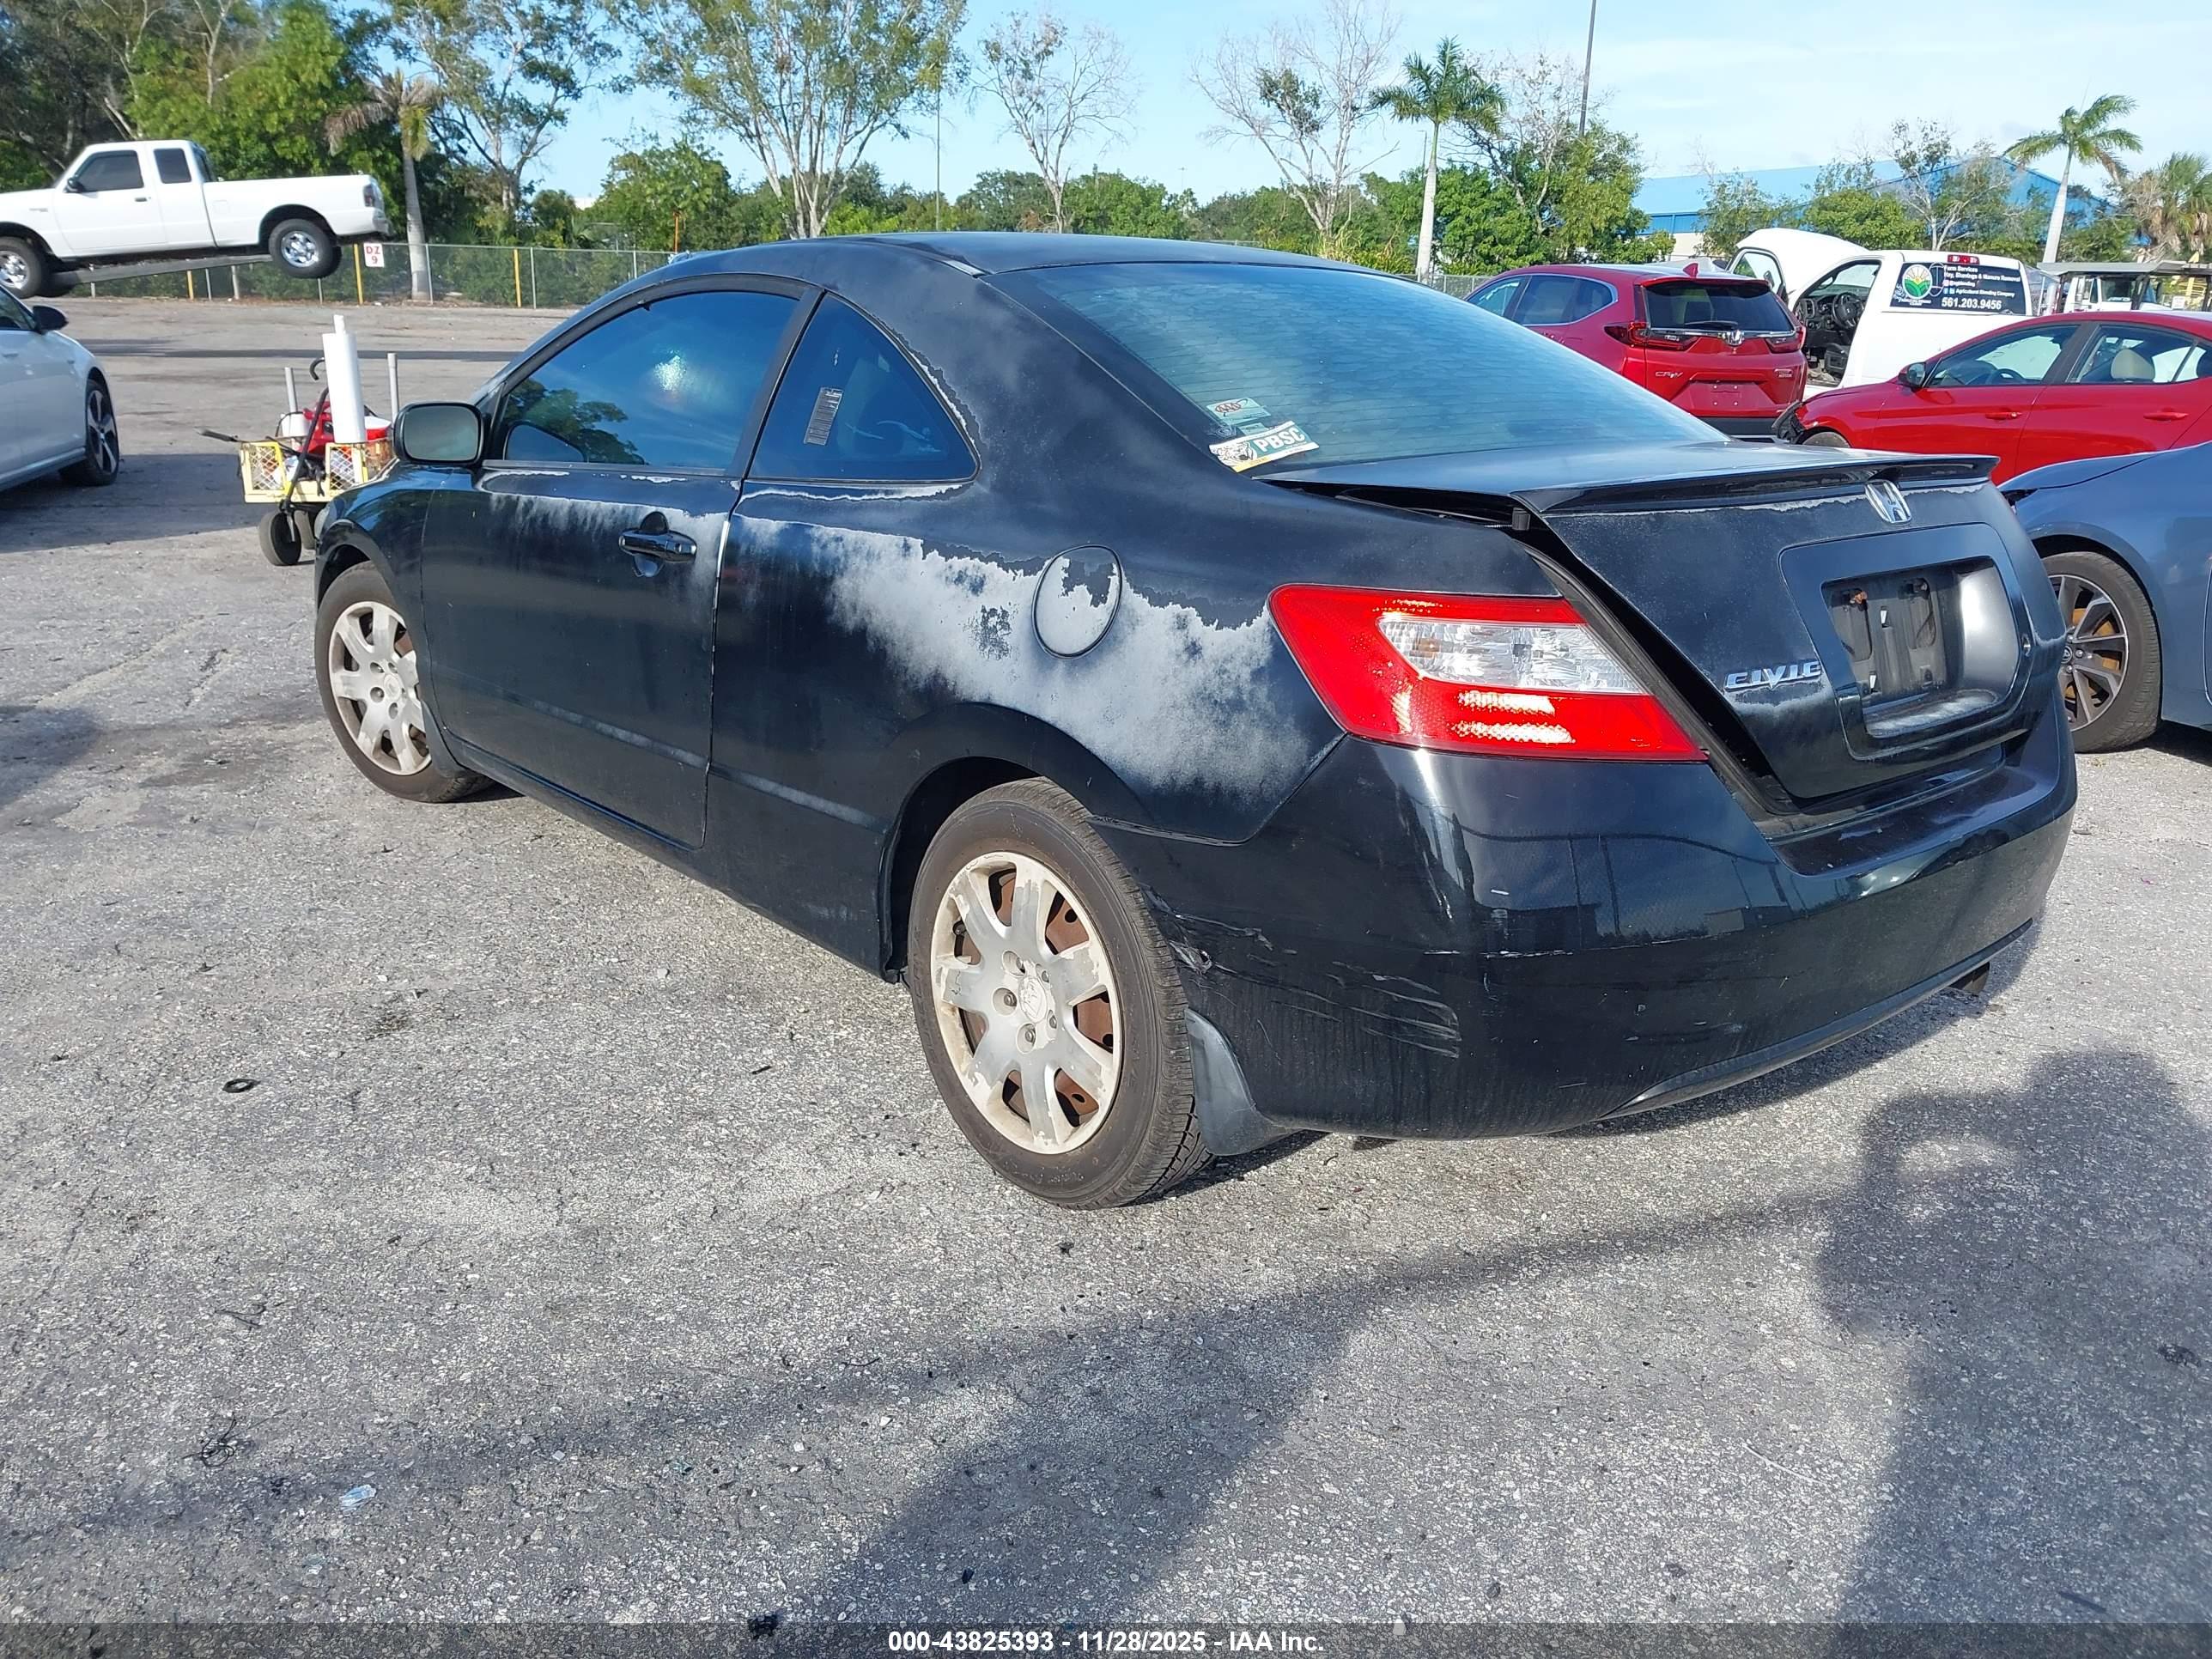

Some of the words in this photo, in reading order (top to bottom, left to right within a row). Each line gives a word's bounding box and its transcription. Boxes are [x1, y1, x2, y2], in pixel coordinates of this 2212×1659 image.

[366, 246, 380, 254] DZ
[371, 255, 378, 264] 9
[1942, 297, 2002, 310] 561.203.9456
[1253, 427, 1305, 452] PBSC
[1724, 660, 1821, 689] CIVIC
